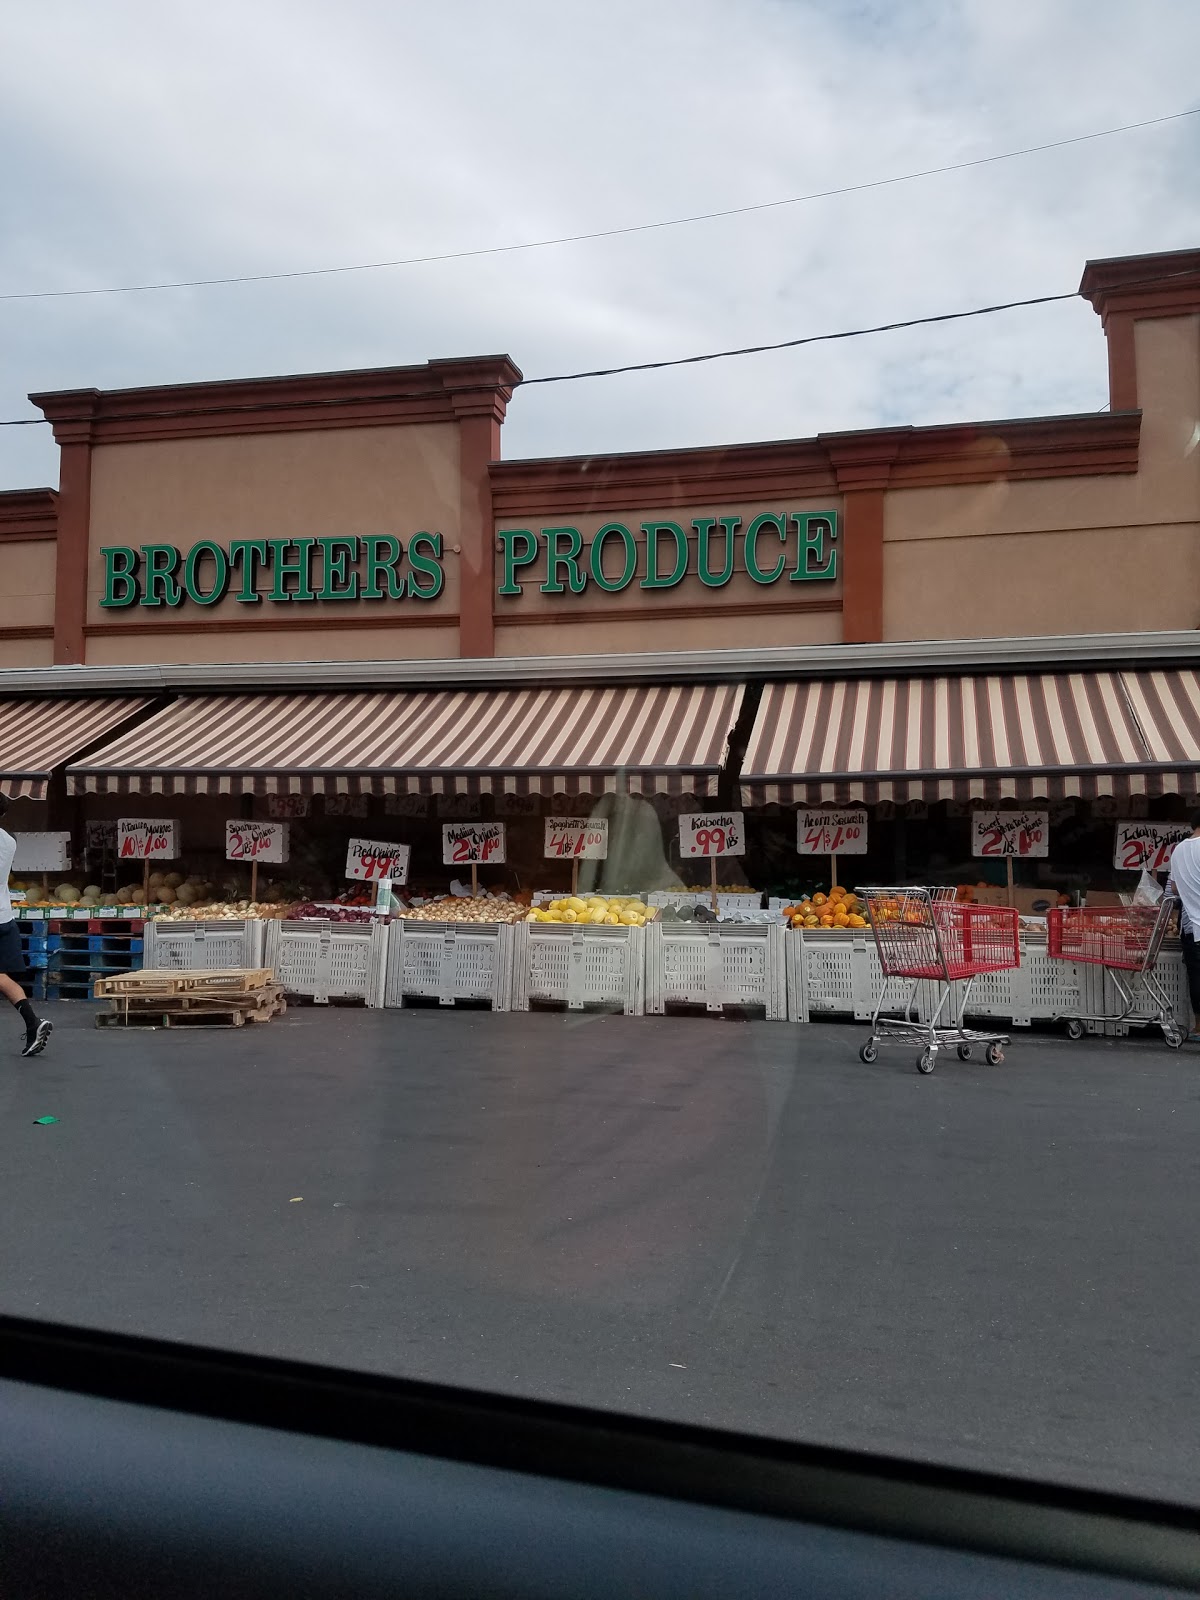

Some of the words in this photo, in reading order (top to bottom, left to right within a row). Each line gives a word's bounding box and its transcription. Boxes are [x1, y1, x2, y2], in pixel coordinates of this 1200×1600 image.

[99, 530, 444, 608] BROTHERS
[498, 510, 839, 595] PRODUCE
[691, 815, 735, 831] Kabocha
[804, 813, 830, 828] Acorn
[831, 813, 864, 826] Squash
[977, 815, 1001, 835] Sweet
[1022, 817, 1043, 837] Yams
[251, 827, 277, 842] Onions
[447, 826, 476, 845] Medium
[472, 825, 500, 845] Onions
[1121, 826, 1158, 845] Idaho
